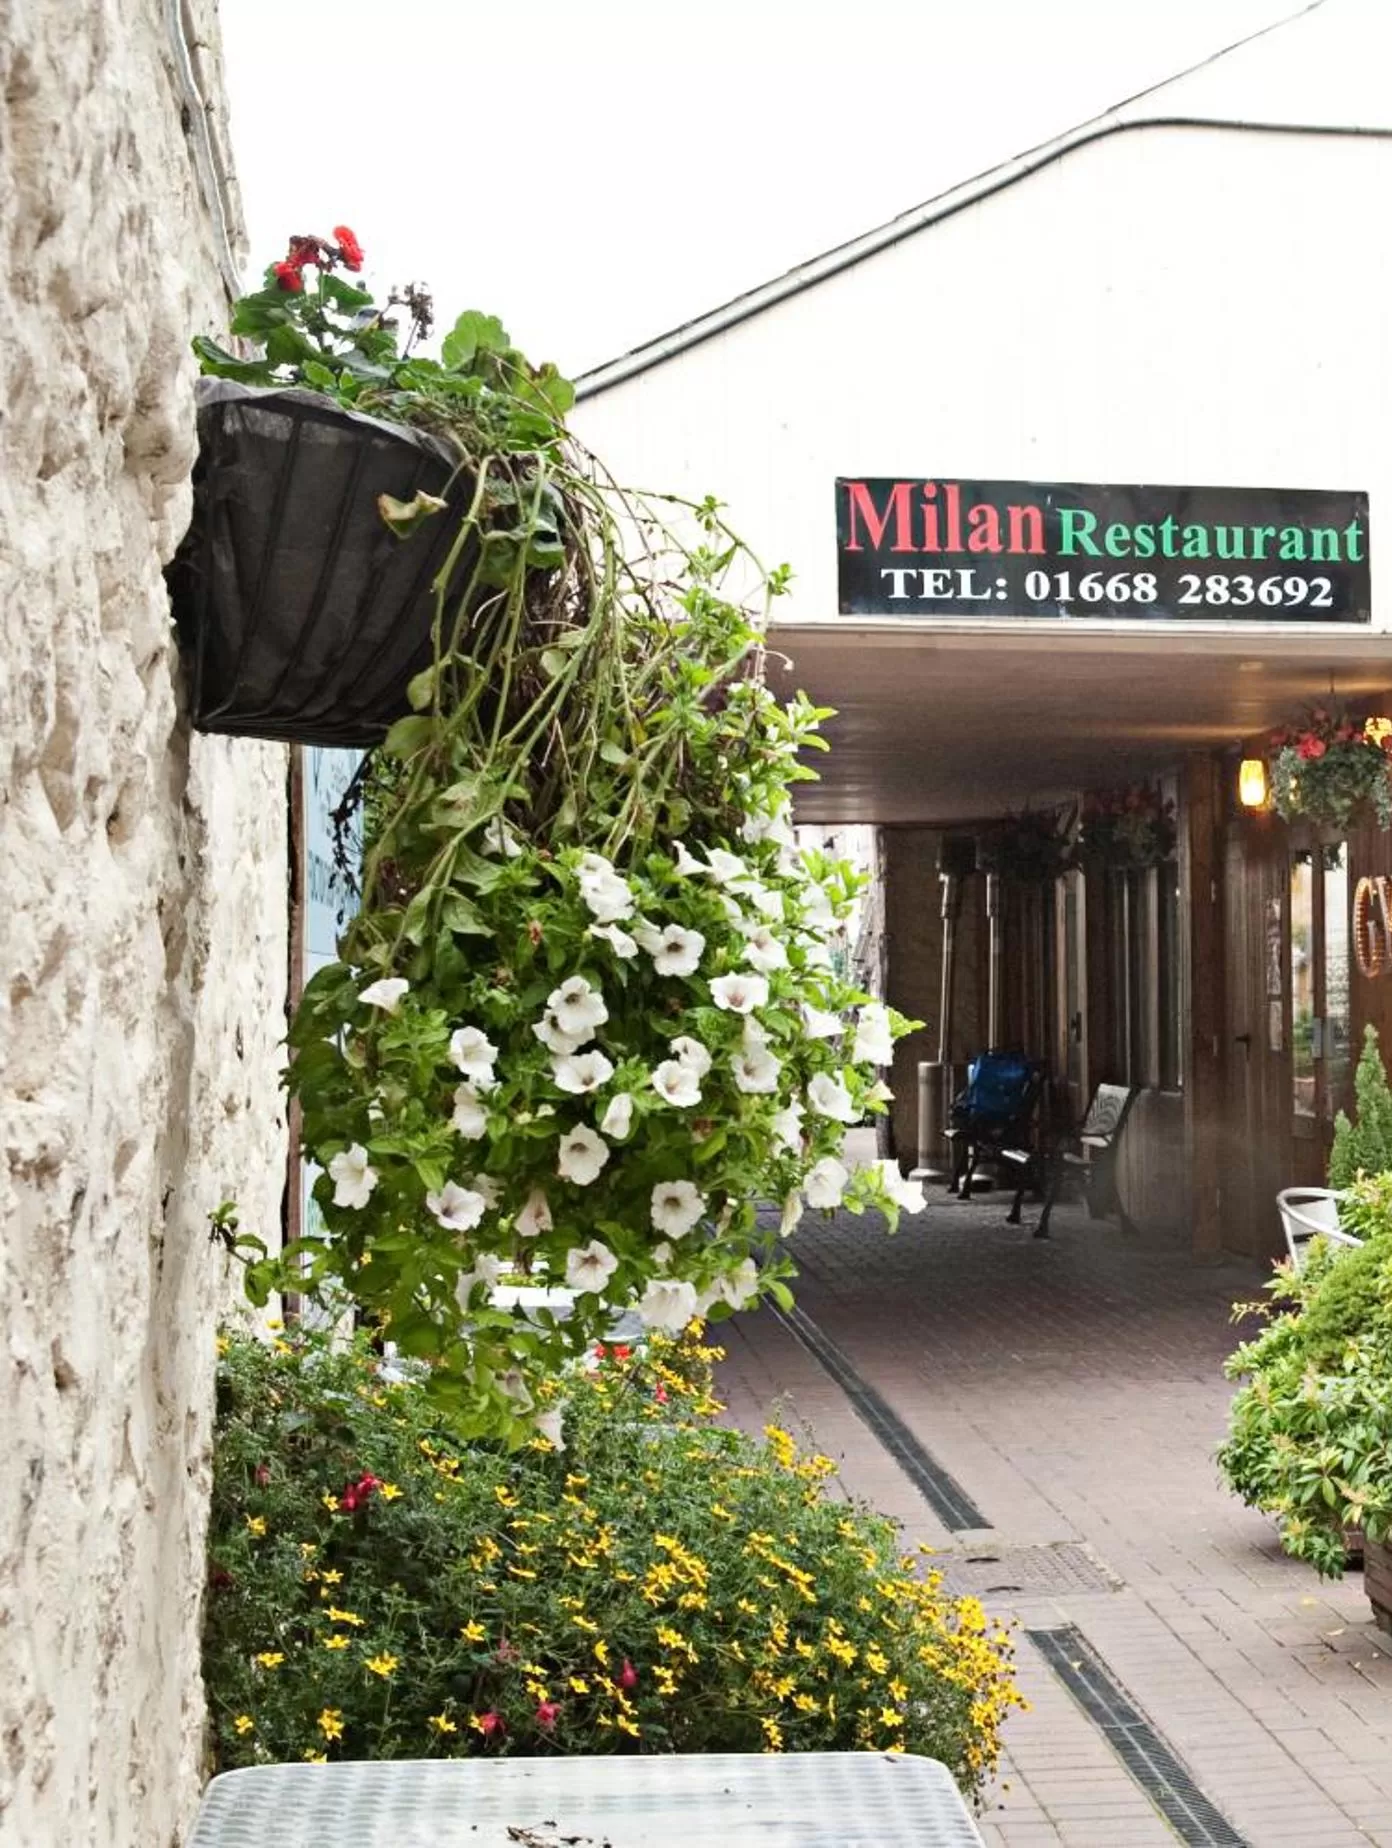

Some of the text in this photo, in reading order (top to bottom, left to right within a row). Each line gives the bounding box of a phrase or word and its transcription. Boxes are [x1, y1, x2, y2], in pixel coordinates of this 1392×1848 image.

[842, 481, 1364, 562] Milan Restaurant
[880, 568, 1334, 607] TEL: 01668 283692
